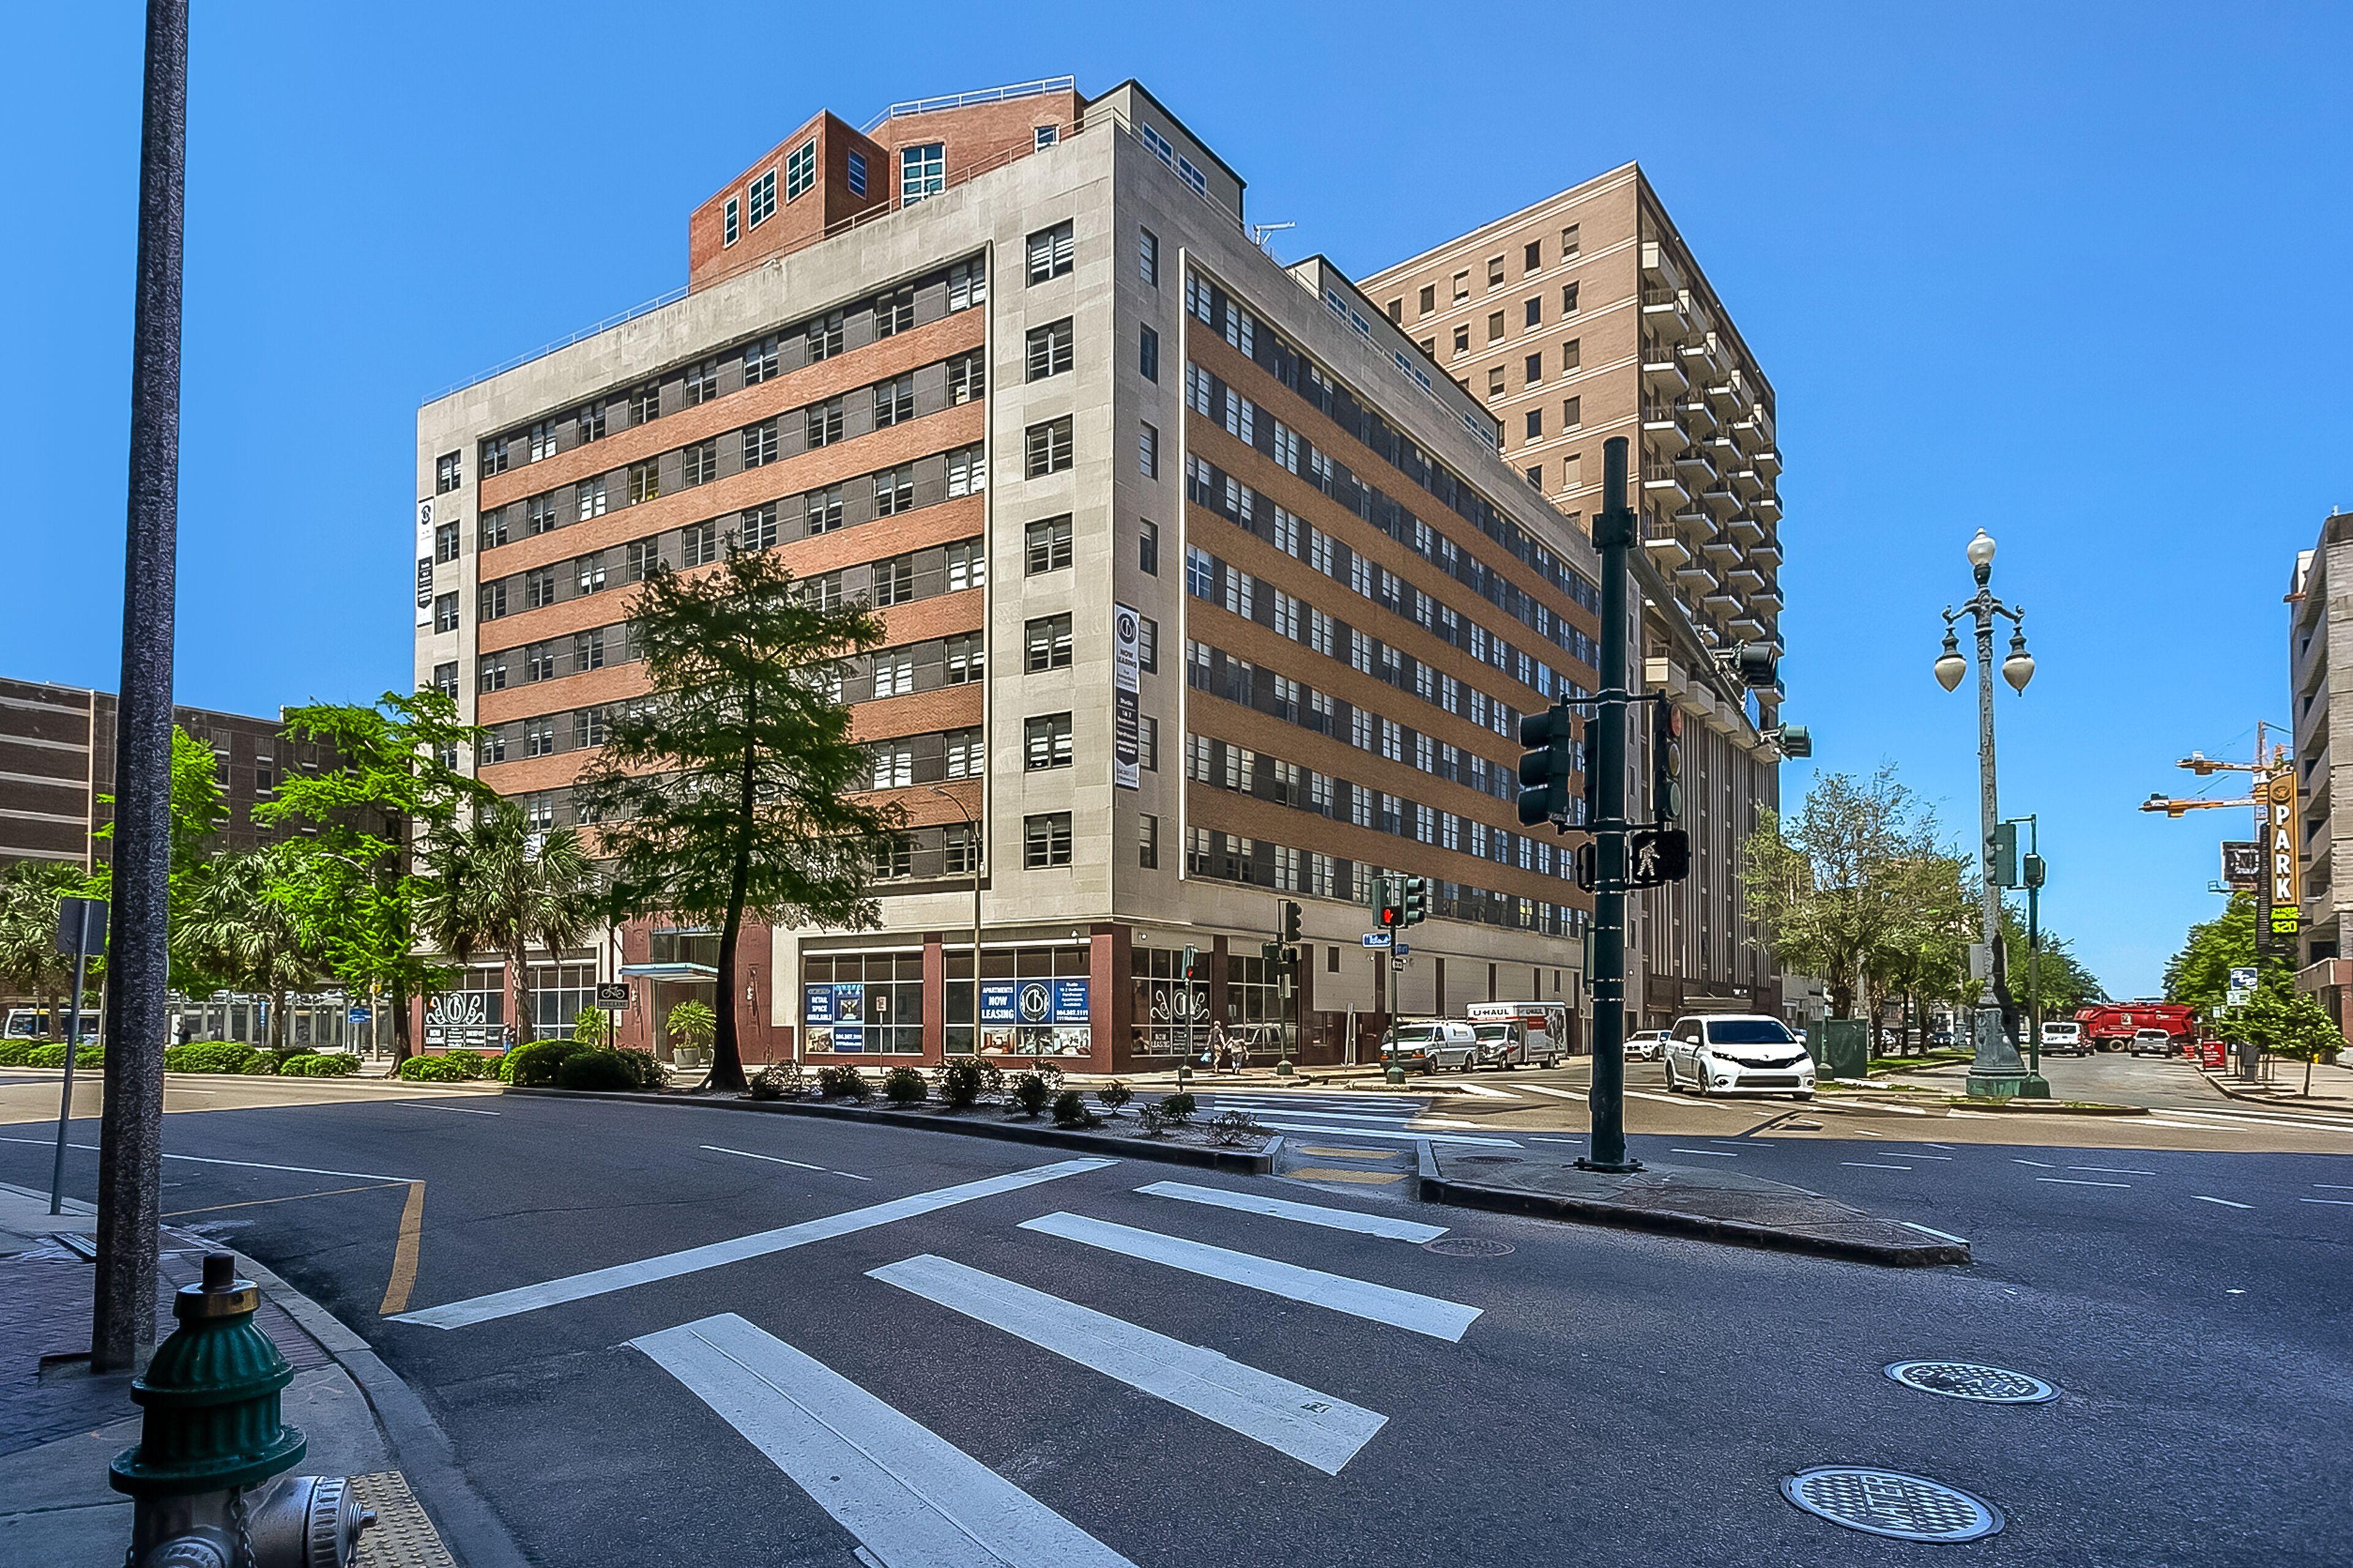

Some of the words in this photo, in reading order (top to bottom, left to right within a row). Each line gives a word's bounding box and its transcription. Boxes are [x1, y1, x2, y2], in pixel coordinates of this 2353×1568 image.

[2274, 805, 2292, 899] PARK
[2272, 920, 2298, 933] $20
[2231, 970, 2257, 987] ace
[988, 996, 1008, 1006] NOW
[981, 1009, 1014, 1019] LEASING
